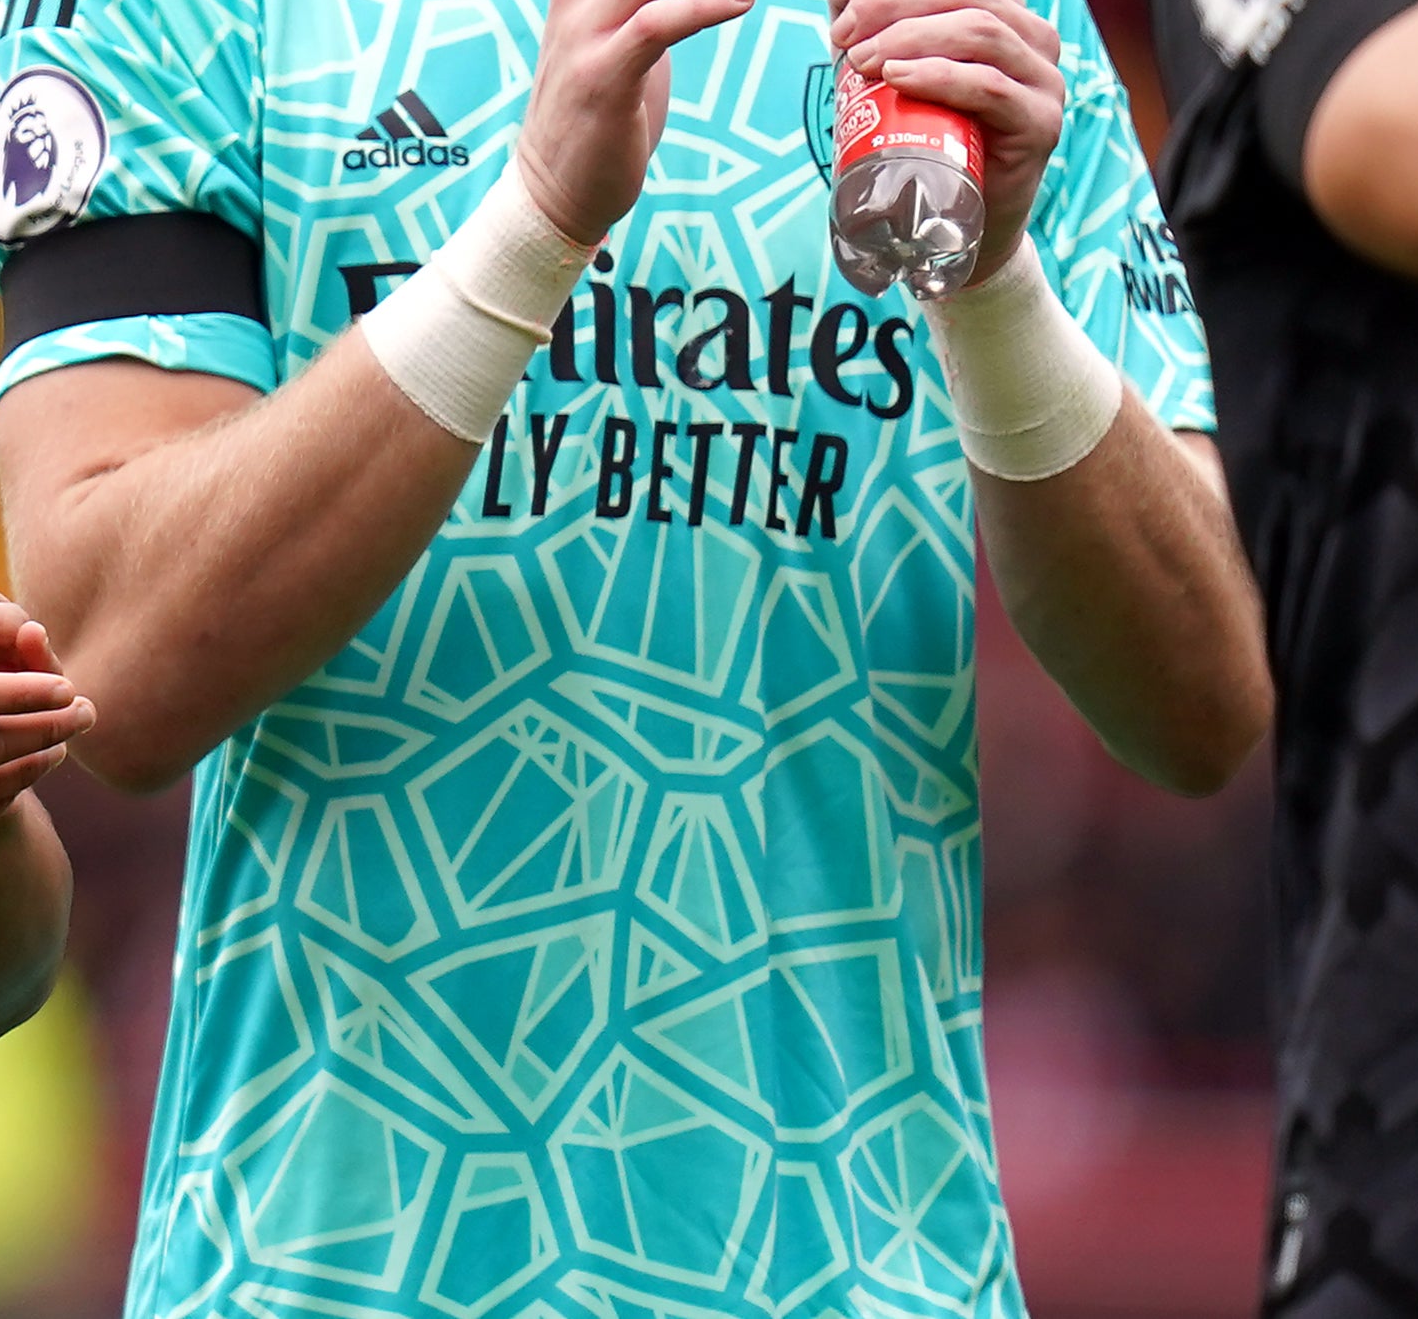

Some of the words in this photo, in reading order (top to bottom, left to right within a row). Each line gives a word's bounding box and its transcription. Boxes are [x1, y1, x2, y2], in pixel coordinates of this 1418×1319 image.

[343, 138, 470, 170] adidas
[887, 132, 927, 146] 330ml
[482, 413, 568, 518] LY
[595, 417, 849, 540] BETTER
